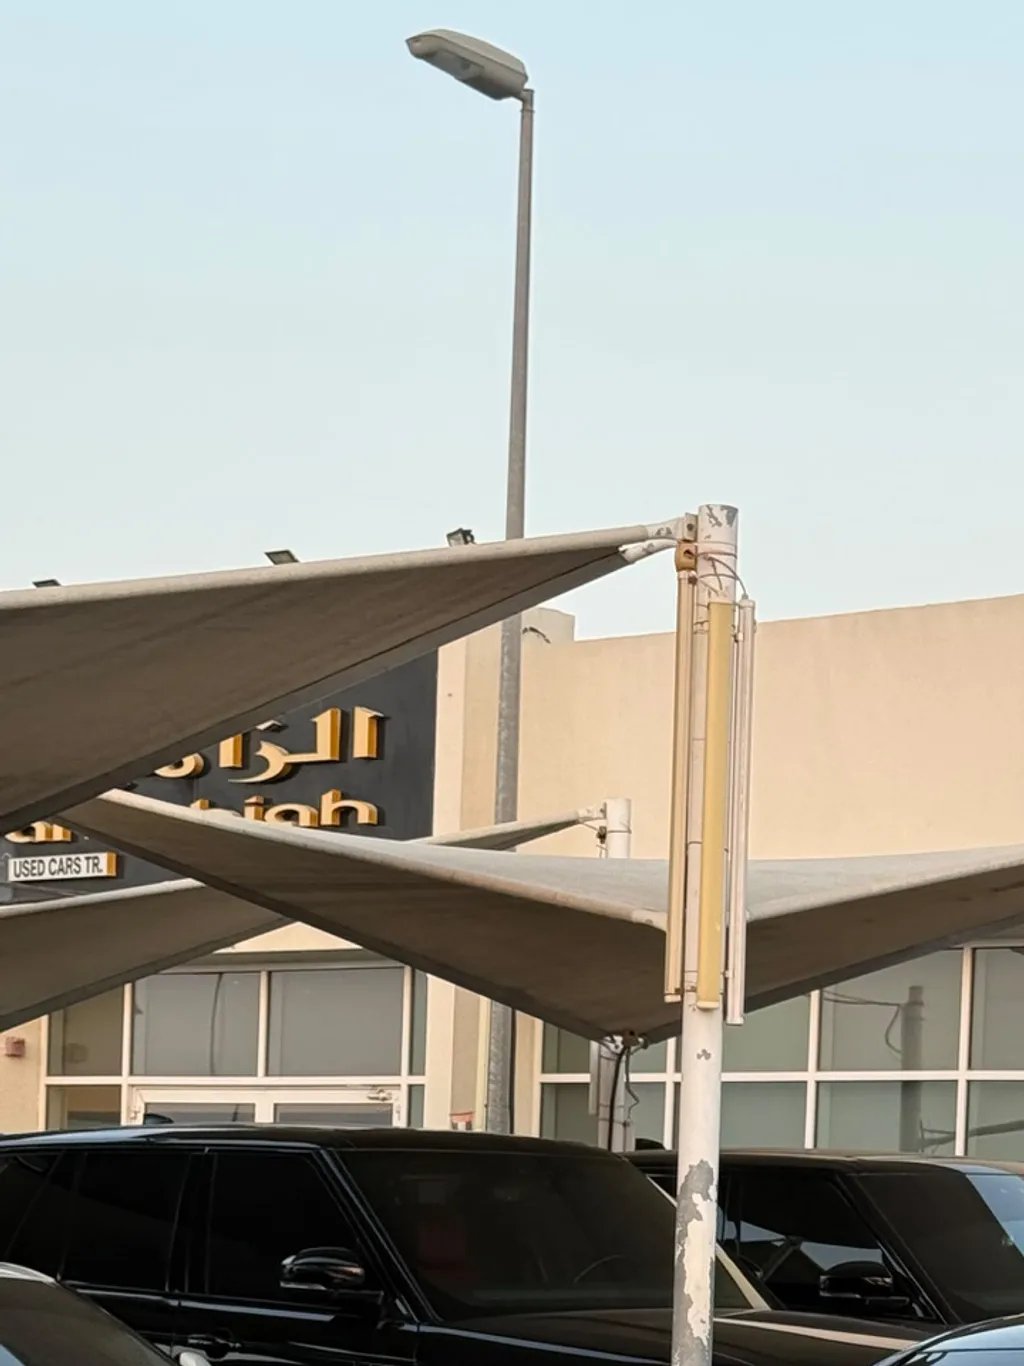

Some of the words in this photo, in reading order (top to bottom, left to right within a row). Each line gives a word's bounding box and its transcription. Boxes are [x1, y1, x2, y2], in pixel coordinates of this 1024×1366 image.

[13, 858, 46, 878] USED
[48, 856, 82, 876] CARS
[84, 855, 103, 874] TR.
